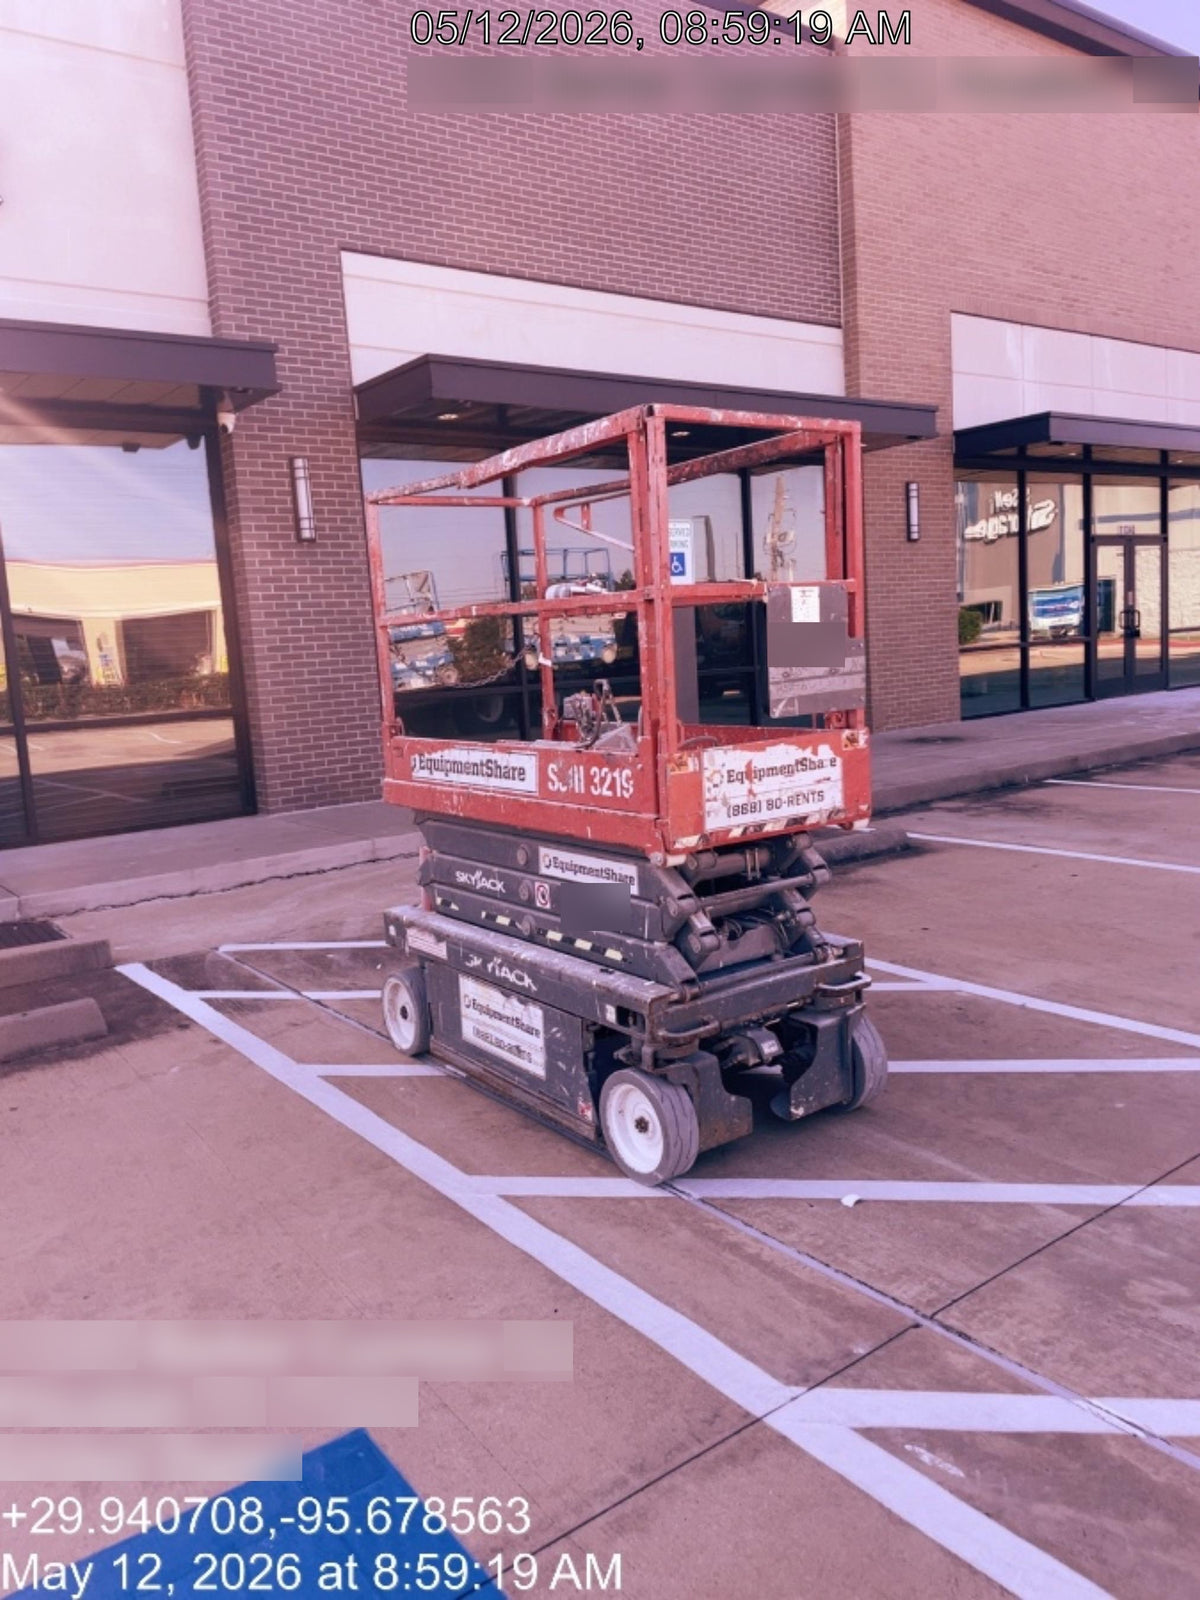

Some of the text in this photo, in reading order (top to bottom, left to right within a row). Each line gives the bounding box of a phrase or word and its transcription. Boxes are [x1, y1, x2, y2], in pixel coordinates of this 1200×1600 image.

[419, 754, 526, 783] EquipmentShare
[726, 757, 837, 784] EqipmentShae
[552, 856, 636, 887] EquipmentShare
